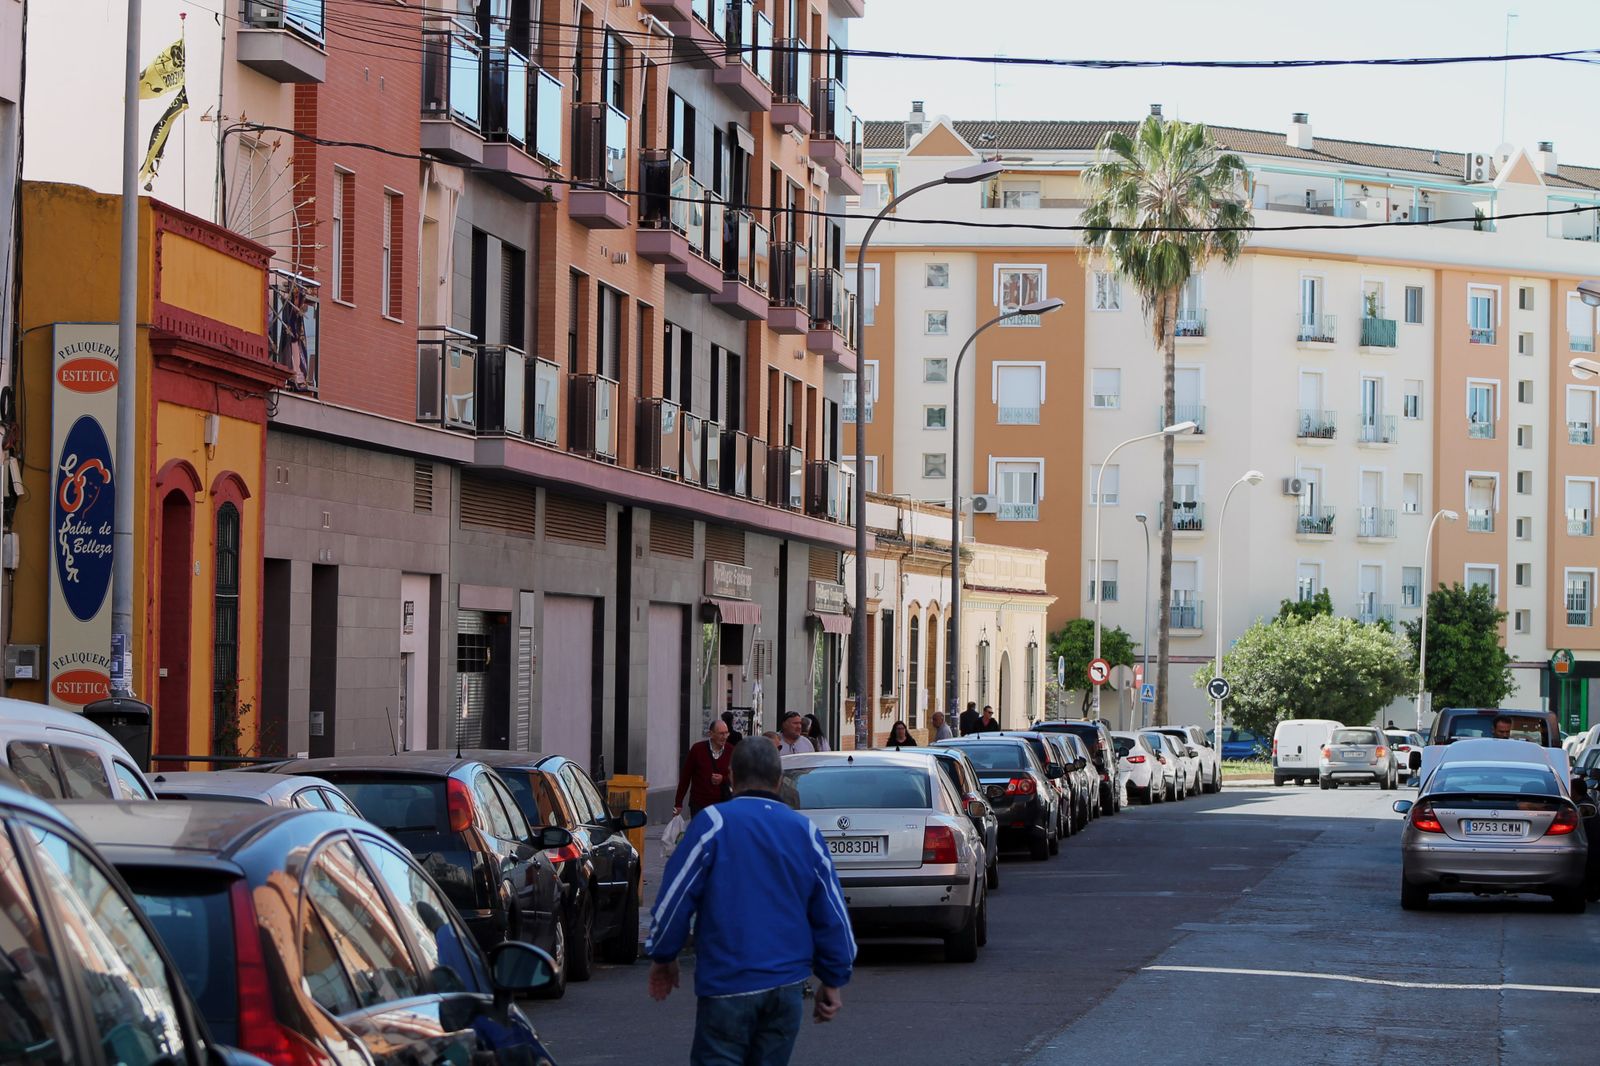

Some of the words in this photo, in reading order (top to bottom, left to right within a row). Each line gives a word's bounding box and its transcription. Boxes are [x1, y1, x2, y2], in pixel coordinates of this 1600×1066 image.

[62, 370, 115, 382] ESTETICA
[99, 521, 112, 535] de
[73, 537, 113, 559] Belleza
[56, 681, 109, 694] ESTETICA
[1472, 822, 1498, 832] 9753
[1501, 823, 1521, 832] CWM
